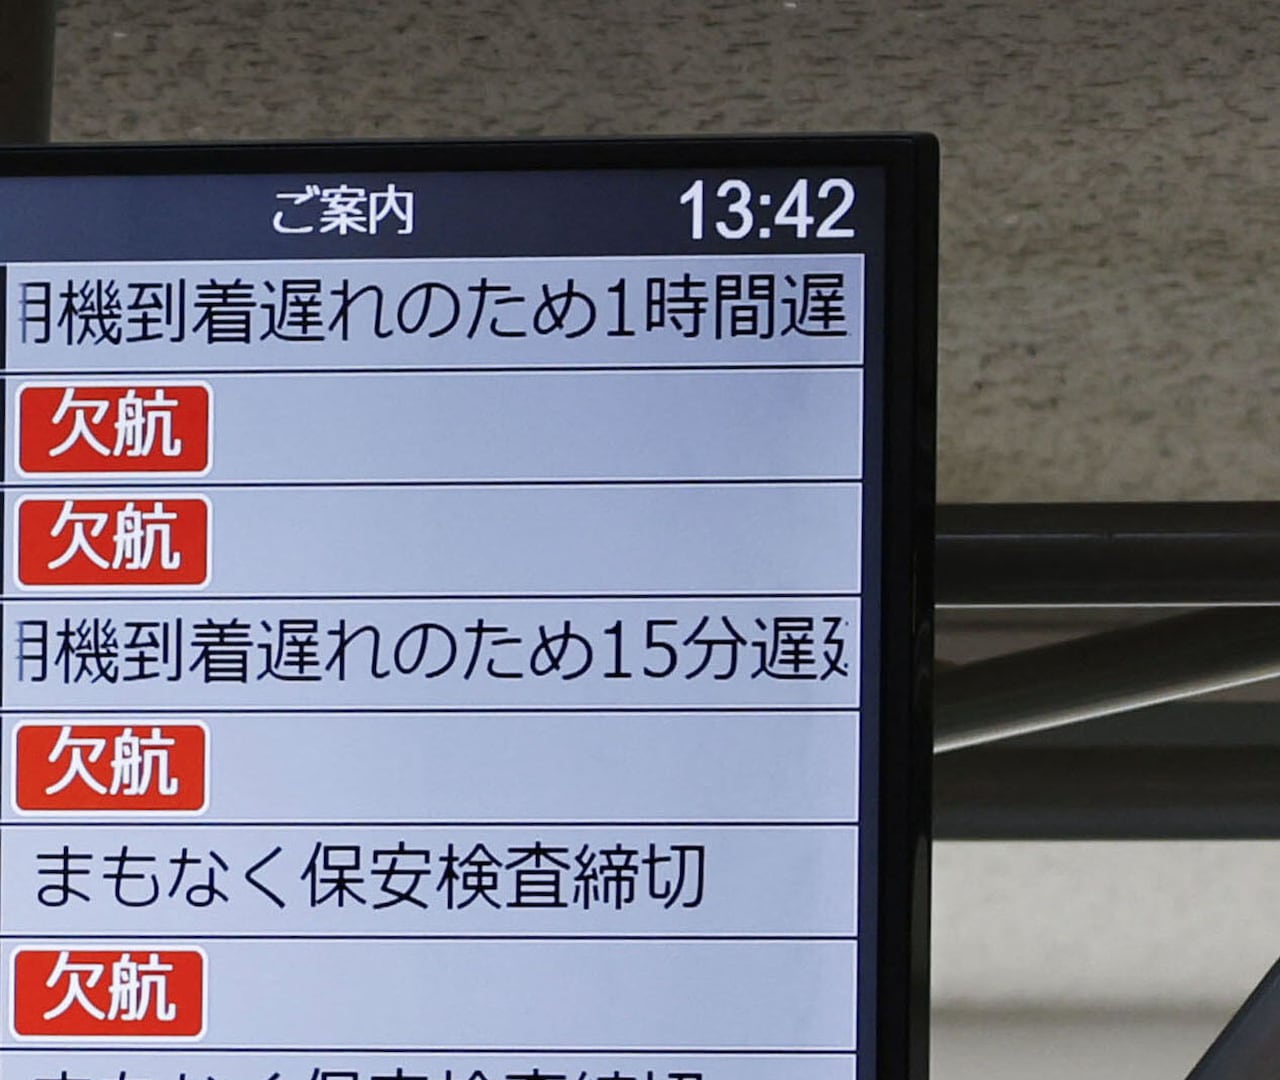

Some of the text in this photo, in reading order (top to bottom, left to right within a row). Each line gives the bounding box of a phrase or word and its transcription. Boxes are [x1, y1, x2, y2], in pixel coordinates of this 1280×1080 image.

[272, 183, 414, 236] ご案内
[679, 178, 855, 241] 13:42
[49, 387, 182, 458] 欠航
[47, 500, 181, 571] 欠航
[45, 725, 178, 796] 欠航
[34, 841, 707, 911] まもなく保安検査締切
[43, 951, 176, 1022] 欠航
